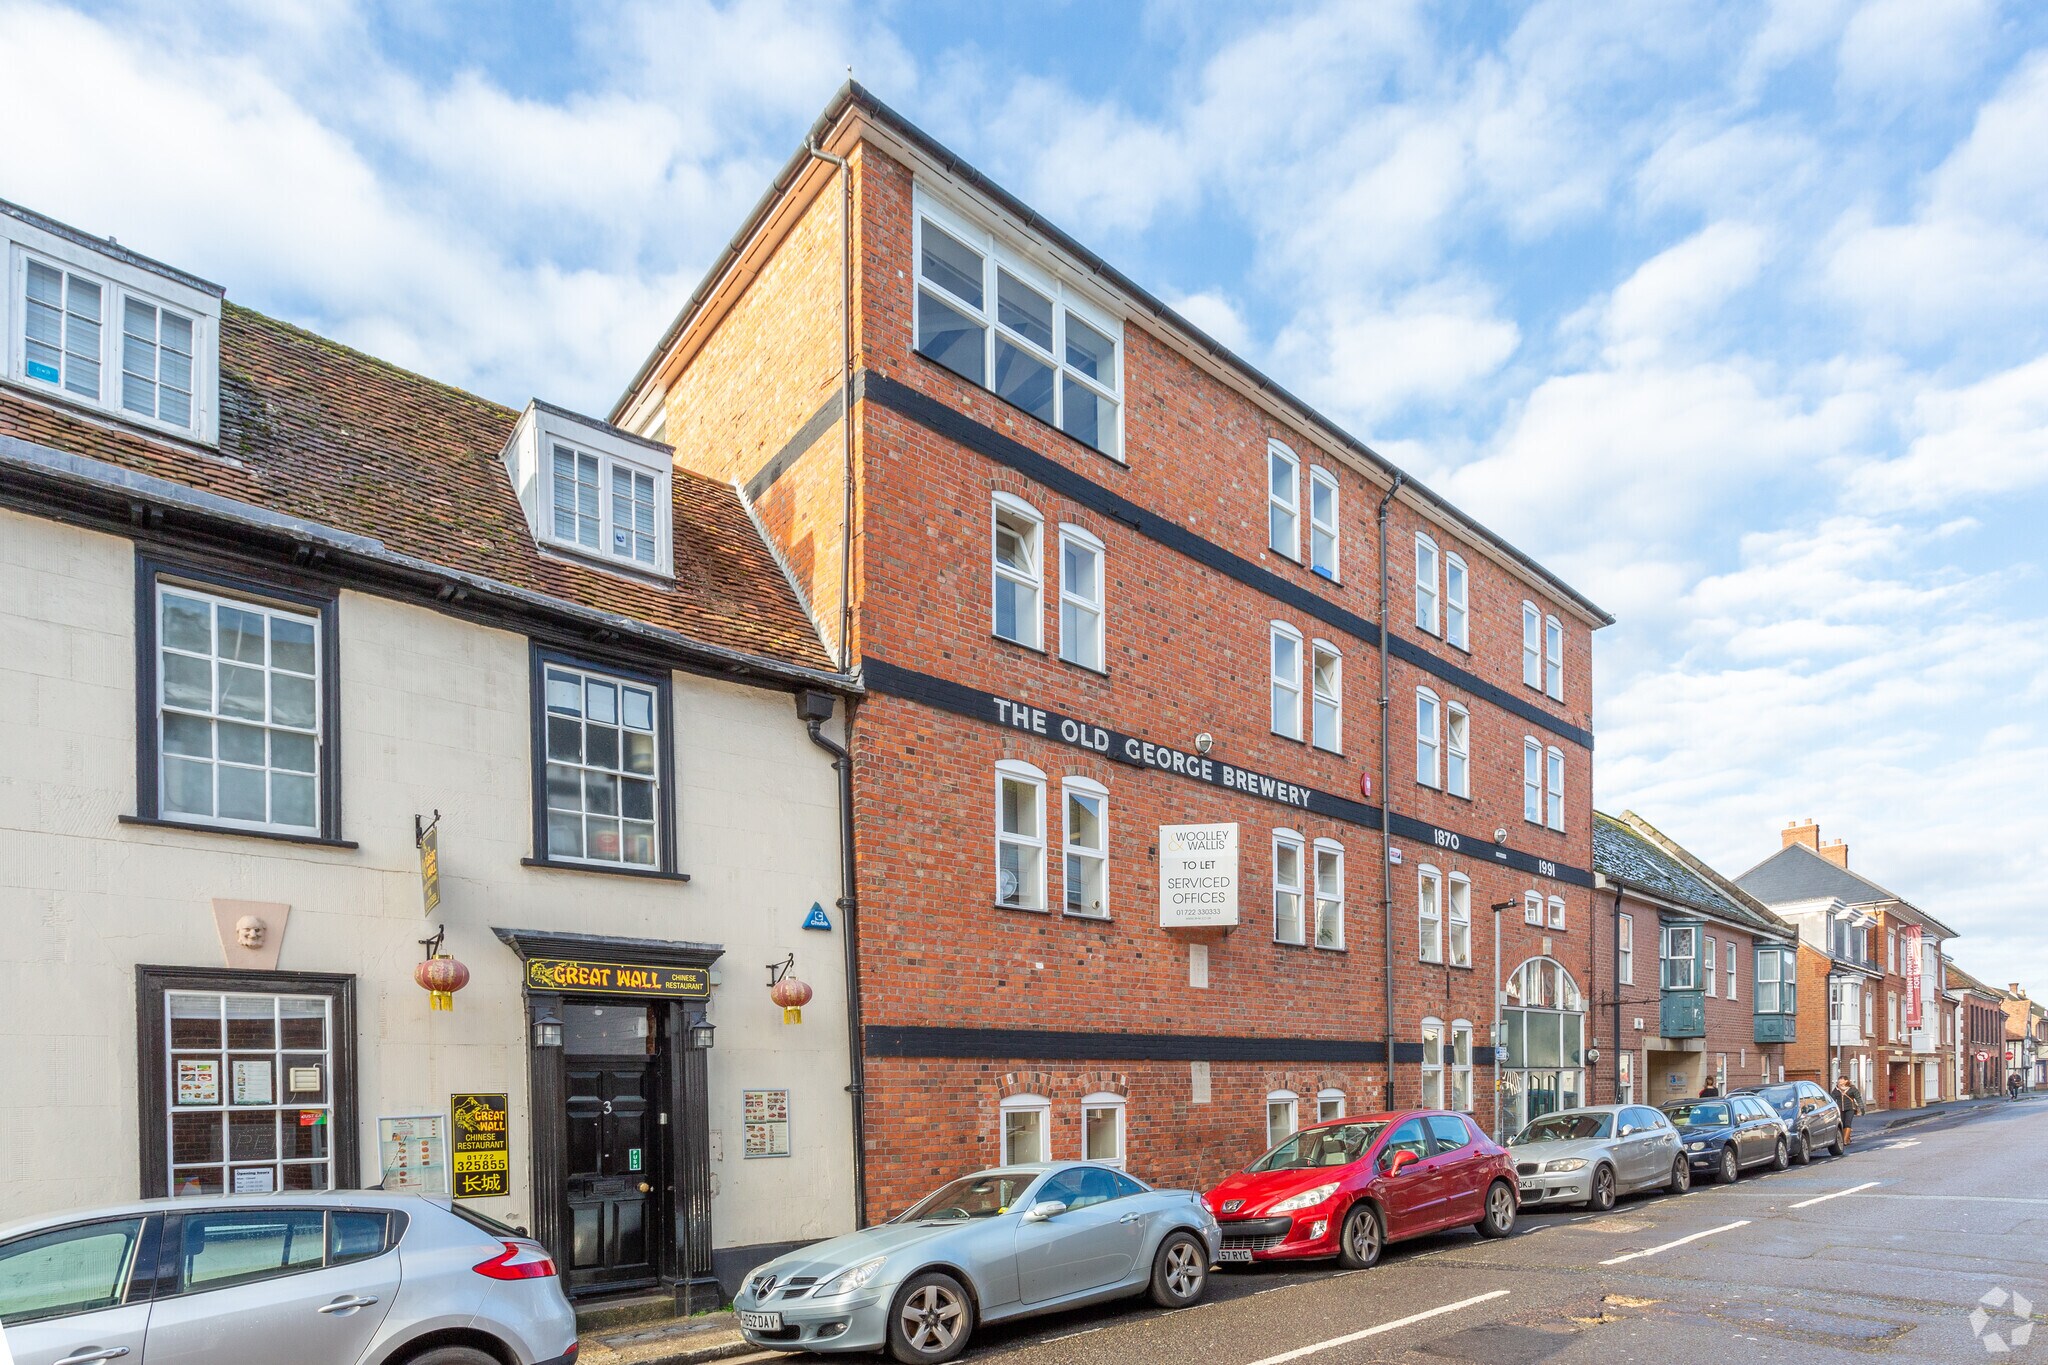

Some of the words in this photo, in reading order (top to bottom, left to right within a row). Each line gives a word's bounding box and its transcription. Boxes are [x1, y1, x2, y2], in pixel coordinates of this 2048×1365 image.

[993, 697, 1047, 734] THE
[1061, 720, 1109, 752] OLD
[1125, 738, 1213, 782] GEORGE
[1223, 766, 1311, 807] BREWERY
[1175, 830, 1229, 842] WOOLLEY
[1434, 828, 1460, 850] 1870
[1187, 840, 1225, 850] WALLIS
[1182, 861, 1197, 870] TO
[1200, 860, 1216, 870] LET
[1538, 859, 1556, 877] 1991
[1167, 876, 1231, 889] SERVICED
[1172, 891, 1226, 905] OFFICES
[1197, 908, 1221, 916] 330333
[810, 919, 829, 927] Chubb
[553, 965, 611, 987] GREAT
[616, 969, 662, 990] WALL
[671, 973, 697, 982] CHINESE
[665, 981, 704, 990] RESTAURANT
[603, 1100, 612, 1115] 3
[474, 1110, 505, 1121] GREAT
[479, 1121, 506, 1132] WALL
[217, 1132, 290, 1151] OPEN
[465, 1133, 496, 1142] CHINESE
[457, 1140, 504, 1150] RESTAURANT
[457, 1160, 506, 1171] 325855
[462, 1173, 501, 1193] 长城
[1232, 1251, 1249, 1260] RYC
[758, 1315, 775, 1329] DAV
